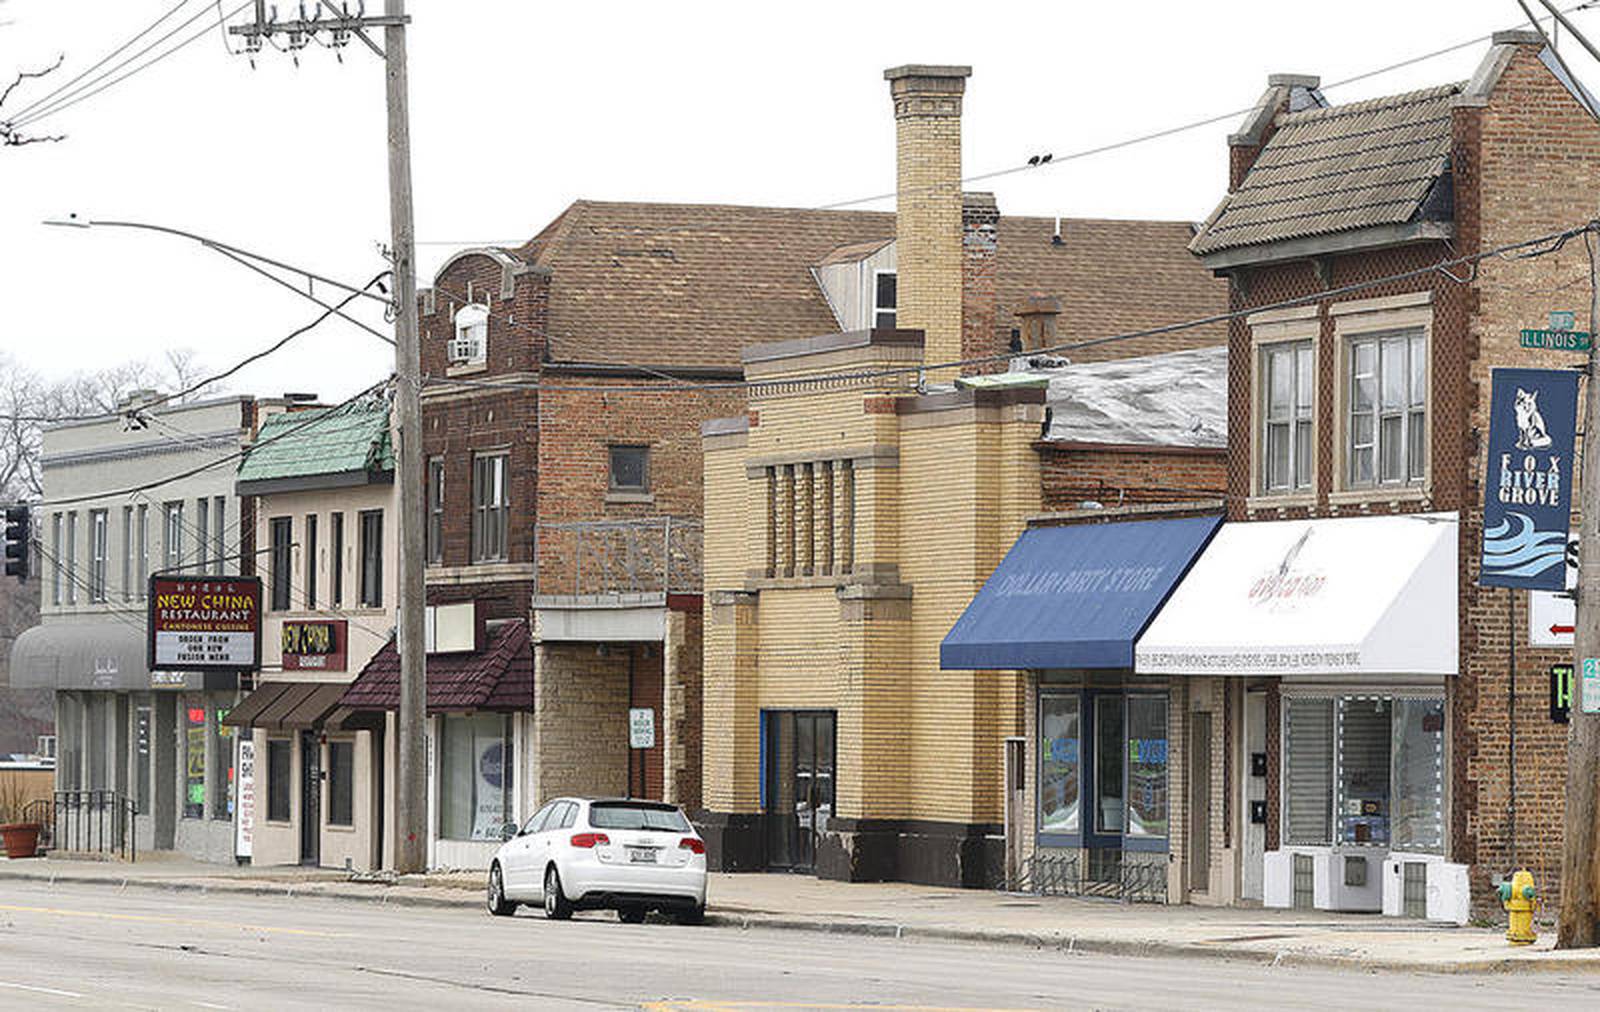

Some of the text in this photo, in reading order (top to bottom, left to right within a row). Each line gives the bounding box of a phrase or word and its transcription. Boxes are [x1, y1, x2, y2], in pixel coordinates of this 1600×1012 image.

[1521, 332, 1577, 347] ILLINOIS
[1501, 453, 1560, 473] FOX
[1500, 469, 1560, 490] RIVER
[1499, 487, 1559, 506] GROVE
[1104, 566, 1165, 592] STORE
[157, 595, 254, 609] NEW CHINA
[161, 609, 250, 620] RESTAURANT
[162, 623, 250, 631] CANTONESE CUISINE
[179, 635, 229, 643] ORDER FROM
[187, 645, 223, 653] OUR NEW
[177, 653, 230, 661] FUSION MENU
